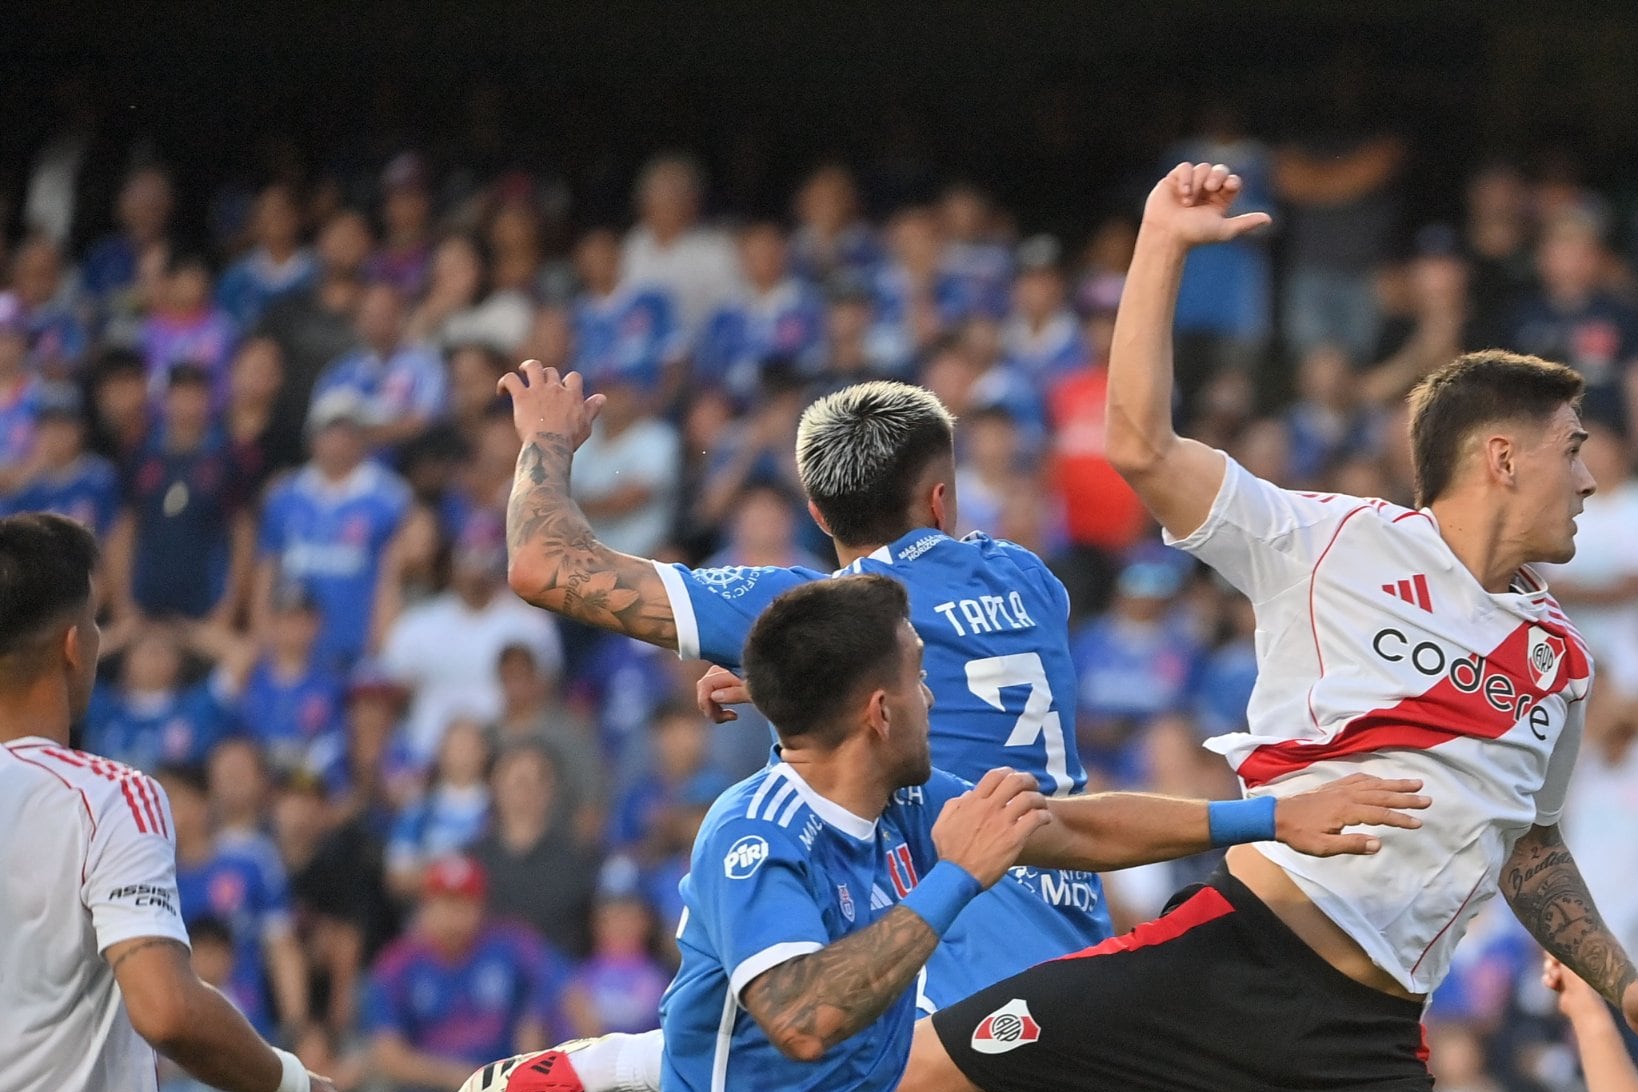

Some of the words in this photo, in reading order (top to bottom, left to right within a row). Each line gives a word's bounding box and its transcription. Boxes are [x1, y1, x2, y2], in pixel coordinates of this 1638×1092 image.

[933, 591, 1036, 636] TAPIA
[1372, 627, 1551, 742] codere
[799, 813, 827, 852] MAC
